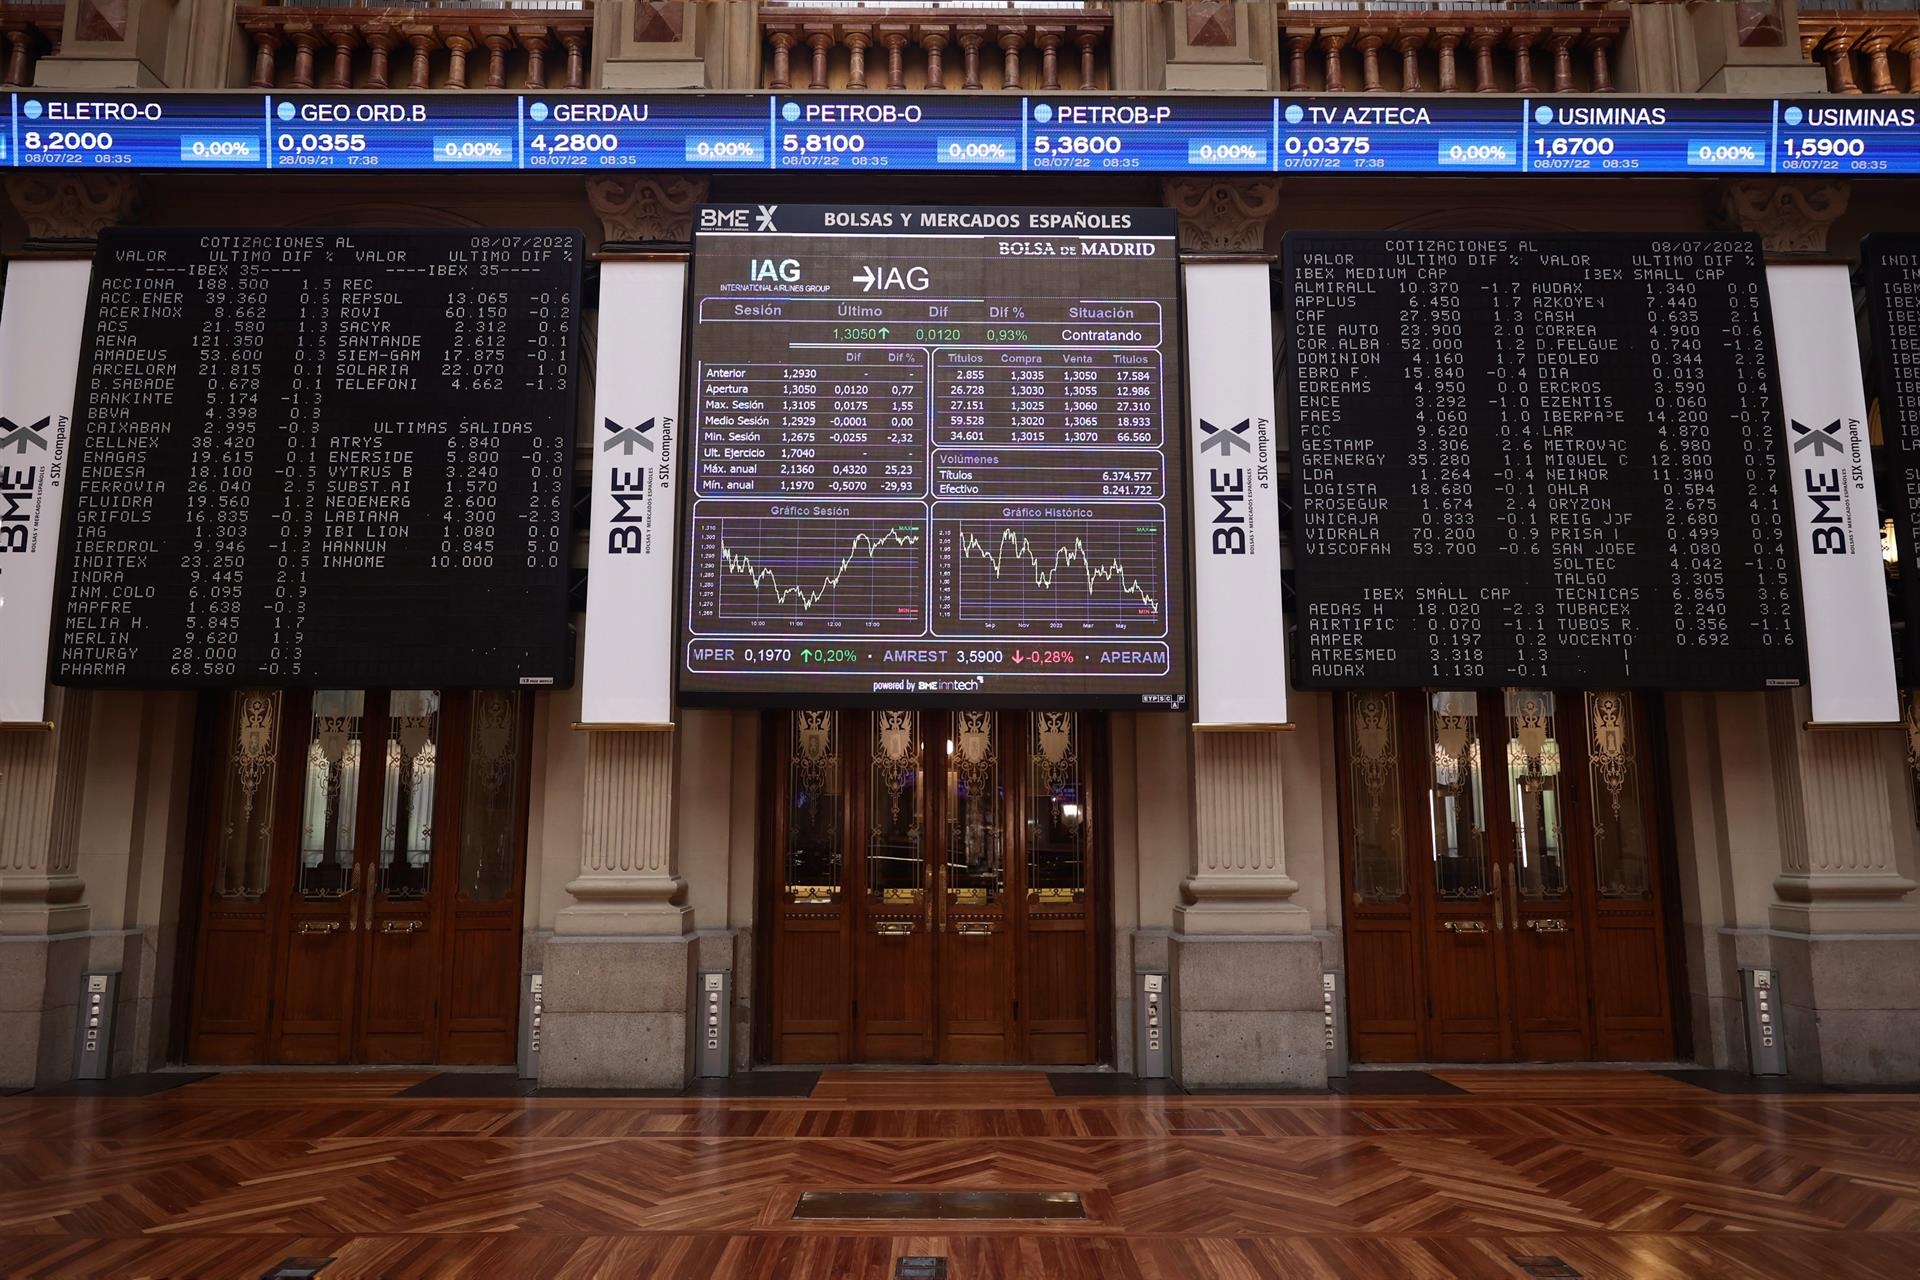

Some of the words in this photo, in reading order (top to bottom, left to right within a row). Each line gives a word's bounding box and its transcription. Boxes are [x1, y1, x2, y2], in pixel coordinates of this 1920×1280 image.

[48, 102, 162, 121] ELETRO-O
[300, 103, 350, 123] GEO
[356, 104, 427, 123] ORD.B
[552, 103, 649, 123] GERDAU
[806, 104, 923, 123] PETROB-O
[1057, 105, 1171, 124] PETROB-P
[1308, 107, 1337, 125] TV
[1343, 107, 1431, 125] AZTECA
[1559, 107, 1666, 126] USIMINAS
[1808, 108, 1915, 127] USIMINAS
[24, 132, 113, 154] 8,2000
[191, 140, 250, 159] 0,00%
[278, 133, 366, 154] 0,0355
[444, 141, 502, 159] 0,00%
[531, 133, 618, 155] 4,2800
[696, 141, 754, 159] 0,00%
[782, 134, 865, 155] 5,8100
[948, 142, 1005, 160] 0,00%
[1034, 135, 1121, 155] 5,3600
[1200, 143, 1257, 161] 0,00%
[1284, 136, 1370, 157] 0,0375
[1449, 143, 1506, 162] 0,00%
[1534, 137, 1614, 158] 1,6700
[1699, 144, 1755, 162] 0,00%
[1784, 138, 1865, 159] 1,5900
[24, 153, 83, 165] 08/07/22
[94, 153, 132, 163] 08:35
[279, 156, 334, 165] 28/09/21
[700, 209, 749, 227] BME
[824, 212, 893, 226] BOLSAS
[900, 213, 912, 226] Y
[921, 213, 1020, 228] MERCADOS
[1029, 211, 1131, 228] ESPAÑOLES
[200, 237, 324, 248] COTIZACIONES
[335, 238, 355, 248] AL
[471, 237, 573, 248] 08/07/2022
[999, 242, 1056, 255] BOLSA
[1081, 243, 1156, 256] MADRID
[1385, 240, 1508, 251] COTIZACIONES
[1519, 241, 1538, 251] AL
[1652, 241, 1753, 252] 08/07/2022
[116, 251, 167, 262] VALOR
[209, 251, 271, 262] ULTIMO
[283, 251, 312, 261] DIF
[751, 259, 800, 282] IAG
[1295, 268, 1334, 279] IBEX
[1345, 268, 1407, 279] MEDIUM
[1418, 268, 1447, 279] CAP
[102, 279, 174, 289] ACCIONA
[197, 279, 269, 290] 188.500
[302, 279, 331, 290] 1.5
[877, 266, 932, 292] IAG
[720, 284, 774, 292] INTERNATIONAL
[805, 285, 830, 293] GROUP
[1294, 283, 1376, 293] ALMIRALL
[1399, 283, 1459, 293] 10.370
[1481, 283, 1520, 293] -1.7
[341, 293, 403, 304] REPSOL
[447, 293, 508, 304] 13.065
[530, 293, 570, 304] -0.6
[734, 304, 782, 316] Sesión
[837, 302, 882, 316] Último
[929, 307, 949, 318] Dif
[989, 307, 1009, 318] Dif
[1013, 307, 1025, 318] %
[1069, 307, 1134, 319] Situación
[338, 336, 421, 347] SANTANDE
[454, 336, 506, 347] 2.612
[832, 328, 876, 341] 1,3050
[916, 329, 961, 341] 0,0120
[986, 330, 1028, 342] 0,93%
[1062, 329, 1142, 341] Contratando
[1001, 354, 1042, 365] Compra
[1063, 355, 1093, 364] Venta
[706, 368, 746, 378] Anterior
[783, 369, 817, 379] 1,2930
[956, 370, 984, 380] 2.855
[1011, 371, 1044, 381] 1,3035
[1063, 371, 1097, 381] 1,3050
[1116, 372, 1150, 381] 17.584
[336, 379, 417, 390] TELEFONI
[451, 379, 503, 390] 4.662
[525, 379, 567, 390] -1.3
[706, 384, 748, 394] Apertura
[783, 385, 816, 395] 1,3050
[834, 385, 868, 395] 0,0120
[891, 385, 913, 395] 0,77
[374, 422, 448, 433] ULTIMAS
[459, 422, 532, 433] SALIDAS
[54, 415, 69, 461] company
[662, 417, 674, 462] company
[1258, 417, 1269, 463] company
[1848, 418, 1862, 463] company
[940, 455, 999, 464] Volúmenes
[51, 462, 61, 479] SIX
[659, 463, 669, 480] SIX
[703, 464, 728, 474] Máx.
[730, 464, 757, 474] anual
[780, 465, 815, 475] 2,1360
[833, 465, 867, 475] 0,4320
[885, 465, 913, 475] 25,23
[939, 470, 973, 480] Títulos
[1102, 471, 1152, 482] 6.374.577
[1258, 465, 1268, 481] SIX
[1852, 465, 1863, 481] SIX
[939, 484, 979, 494] Efectivo
[1102, 486, 1152, 495] 8.241.722
[0, 466, 36, 553] BME
[608, 467, 644, 554] BME
[770, 506, 810, 516] Gráfico
[813, 506, 850, 516] Sesión
[1210, 468, 1246, 555] BME
[1305, 499, 1389, 510] PROSEGUR
[1423, 499, 1473, 510] 1.674
[1805, 469, 1847, 554] BME
[1002, 508, 1042, 518] Gráfico
[1045, 508, 1093, 518] Histórico
[77, 526, 106, 538] IAG
[195, 526, 247, 537] 1.303
[280, 526, 312, 537] 0.9
[1306, 543, 1391, 555] VISCOFAN
[1413, 543, 1476, 554] 53.700
[322, 556, 385, 568] INHOME
[431, 556, 493, 568] 10.000
[527, 556, 558, 567] 0.0
[1364, 588, 1404, 600] IBEX
[1416, 588, 1468, 600] SMALL
[1480, 588, 1511, 600] CAP
[1556, 604, 1630, 615] TUBACEX
[1674, 604, 1726, 615] 2.240
[1116, 622, 1127, 630] May
[744, 649, 791, 663] 0,1970
[814, 650, 857, 663] 0,20%
[883, 650, 948, 662] AMREST
[956, 651, 1003, 664] 3,5900
[1026, 651, 1074, 665] -0,28%
[1100, 651, 1166, 664] APERAM
[61, 663, 126, 675] PHARMA
[170, 663, 235, 675] 68.580
[873, 679, 904, 692] powered
[906, 679, 915, 692] by
